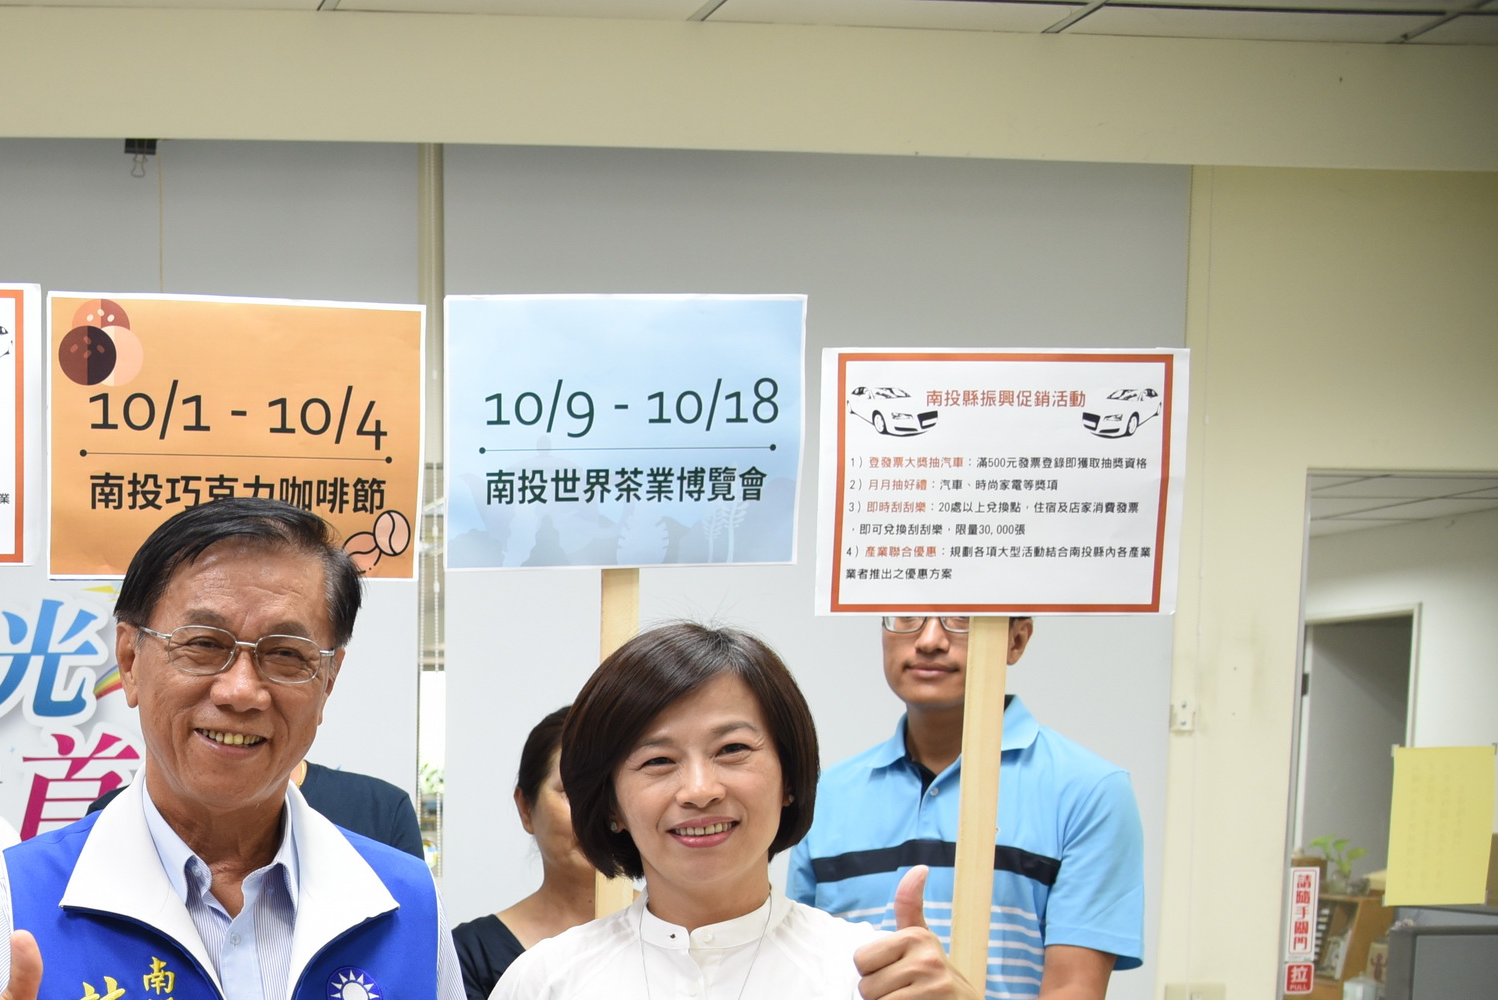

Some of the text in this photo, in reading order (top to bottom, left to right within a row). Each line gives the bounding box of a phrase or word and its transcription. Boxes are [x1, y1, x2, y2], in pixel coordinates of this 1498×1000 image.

[485, 379, 596, 439] 10/9
[647, 377, 780, 432] 10/18
[925, 389, 1087, 409] 南投縣振興促銷活動
[88, 379, 211, 440] 10/1
[268, 385, 388, 451] 10/4
[485, 466, 768, 506] 南投世界茶業博覽會
[845, 568, 953, 580] 業者推出之優惠方案
[1290, 965, 1309, 984] 拉
